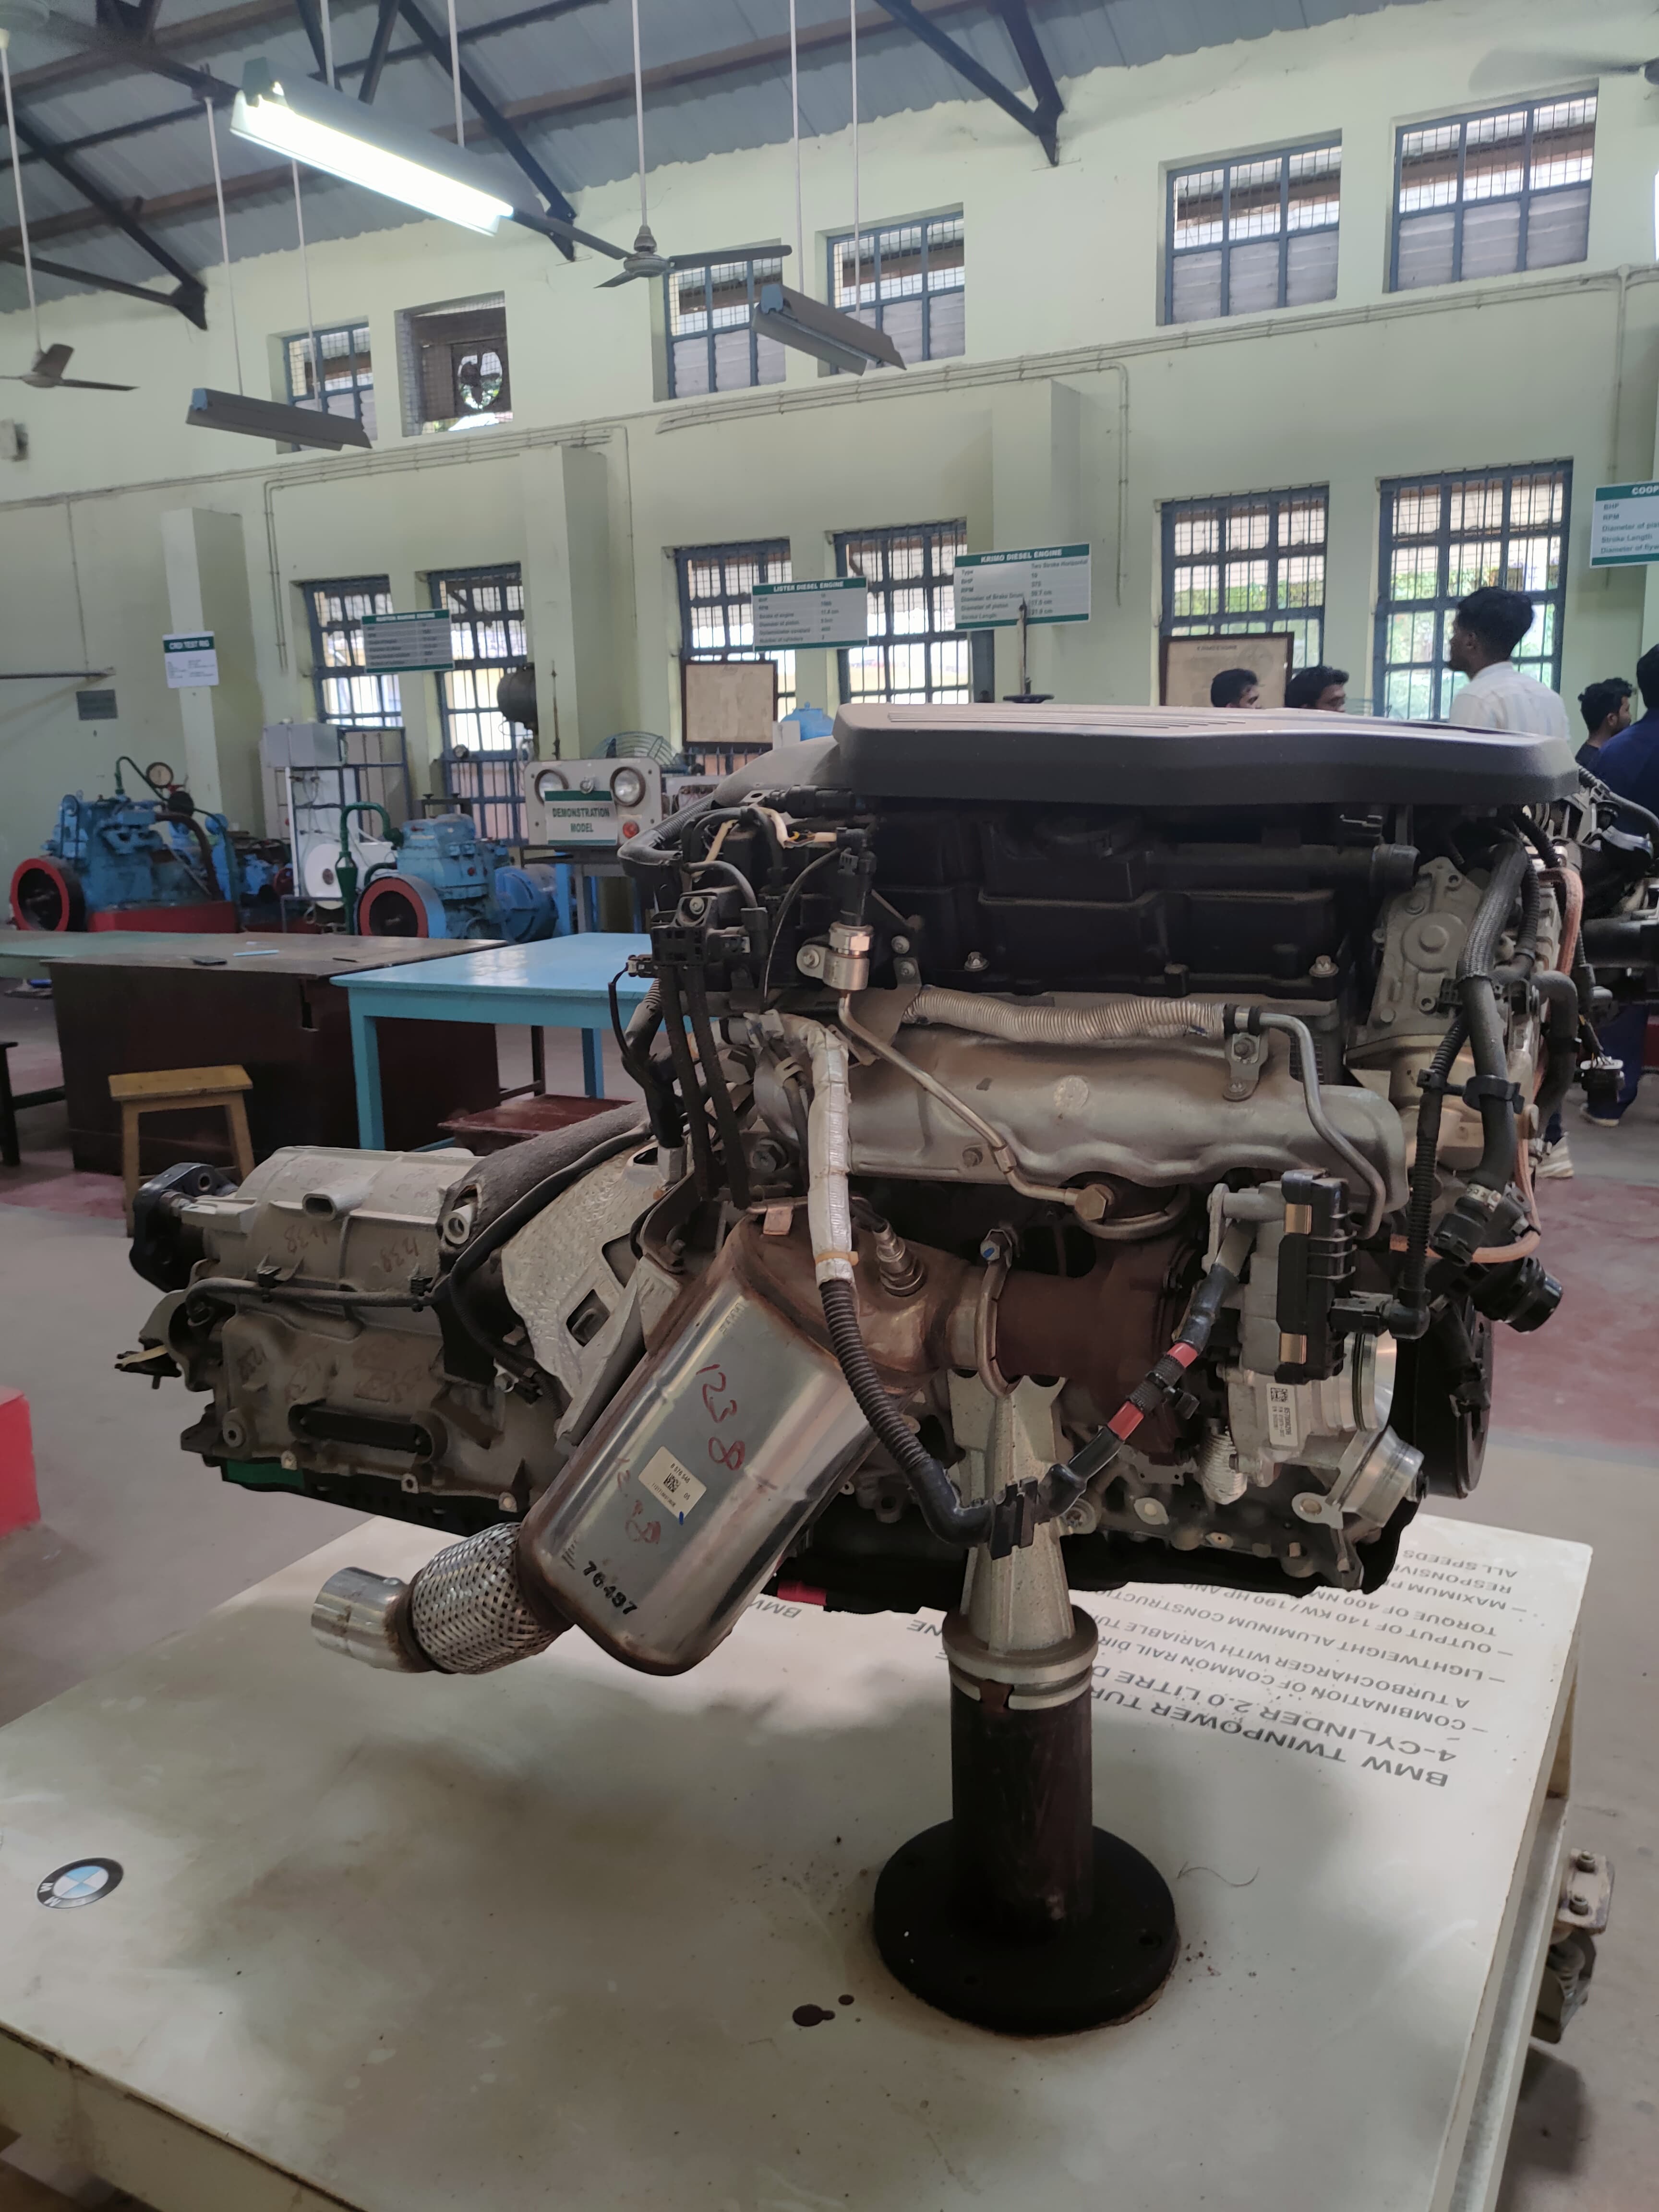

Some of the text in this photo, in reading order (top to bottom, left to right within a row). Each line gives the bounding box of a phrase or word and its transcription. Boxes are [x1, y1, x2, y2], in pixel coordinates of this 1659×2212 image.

[1632, 485, 1659, 495] COOP
[1604, 503, 1619, 511] BHP
[1602, 524, 1635, 532] Diameter
[1627, 533, 1653, 541] Length
[1006, 551, 1032, 561] DIESEL
[1034, 549, 1062, 558] ENGINE
[1601, 545, 1633, 553] Diameter
[553, 807, 610, 817] DEMONSTRATION
[570, 823, 594, 833] MODEL
[696, 1364, 745, 1471] 1238
[1403, 1549, 1518, 1578] ALL SPEEDS
[1394, 1564, 1512, 1595] RESPONSIV
[1224, 1588, 1249, 1602] HP
[1253, 1595, 1286, 1610] 190
[1343, 1596, 1380, 1611] 400
[1407, 1582, 1507, 1611] MAXIMUM
[1301, 1605, 1332, 1619] KW
[1336, 1612, 1370, 1628] 140
[1382, 1606, 1409, 1618] OF
[1374, 1622, 1403, 1634] OF
[1415, 1611, 1498, 1636] TORQUE
[1095, 1590, 1483, 1681] LIGHTWEIGHT ALUMINUM CONSTRUCTI
[1124, 1622, 1216, 1652] VARIABLE
[1405, 1626, 1492, 1654] OUTPUT
[1219, 1644, 1272, 1665] WITH
[1098, 1636, 1466, 1731] COMBINATION OF COMMON RAIL DIR
[1114, 1670, 1201, 1701] LITRE
[1274, 1656, 1449, 1706] TURBOCHARGER
[1207, 1694, 1253, 1713] 2.0
[1455, 1697, 1470, 1709] A
[1091, 1685, 1449, 1787] BMW TWINPOWER TUR
[1259, 1706, 1457, 1762] 4-CYLINDER
[39, 1882, 86, 1907] BMW
